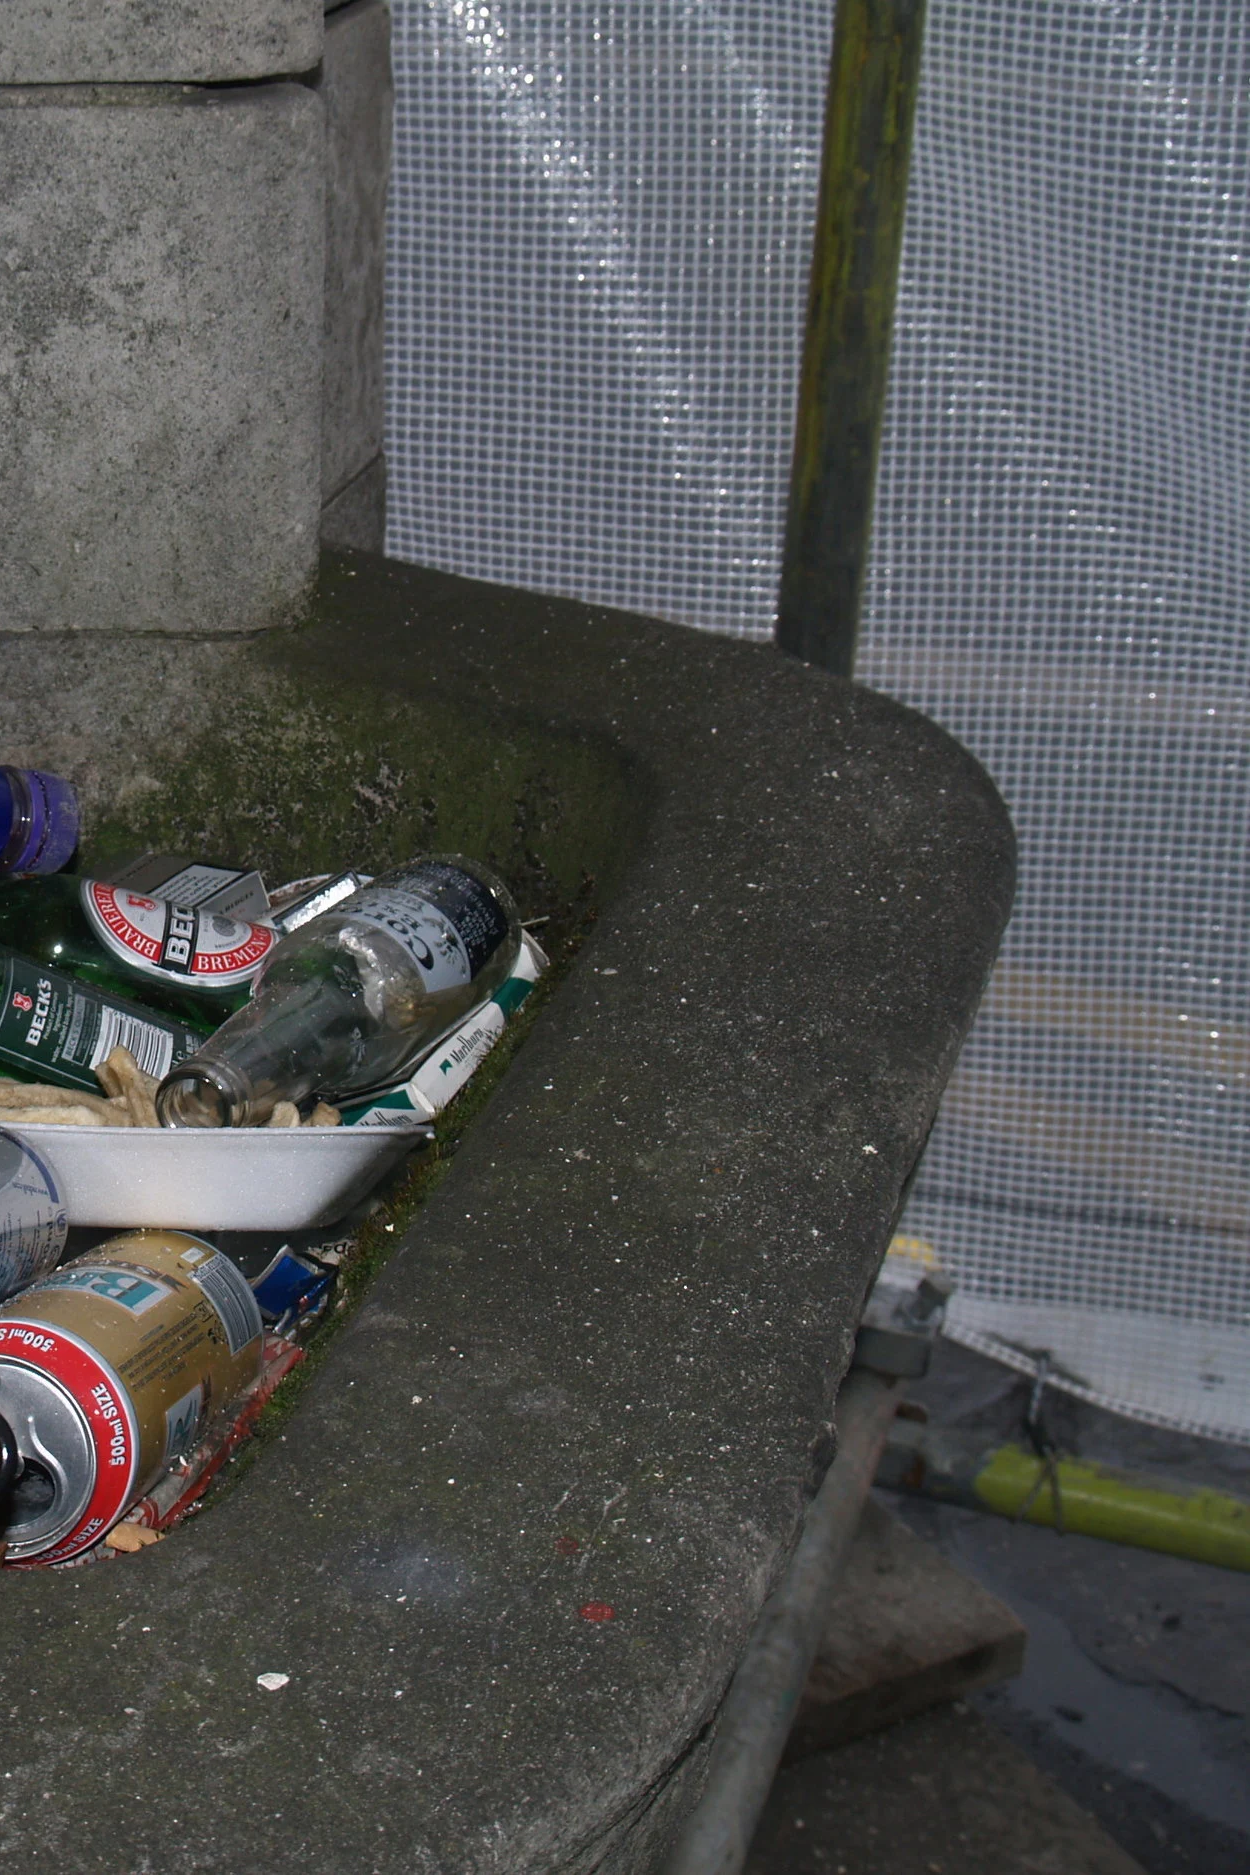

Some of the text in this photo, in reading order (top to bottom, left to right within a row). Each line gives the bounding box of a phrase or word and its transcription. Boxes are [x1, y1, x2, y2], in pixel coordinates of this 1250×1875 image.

[164, 904, 196, 965] BEC
[25, 978, 52, 1047] BECK'S
[450, 1027, 485, 1064] Marlboro
[7, 1328, 55, 1352] 500ml
[91, 1382, 126, 1466] 500ml SIZE
[74, 1517, 104, 1543] SIZE
